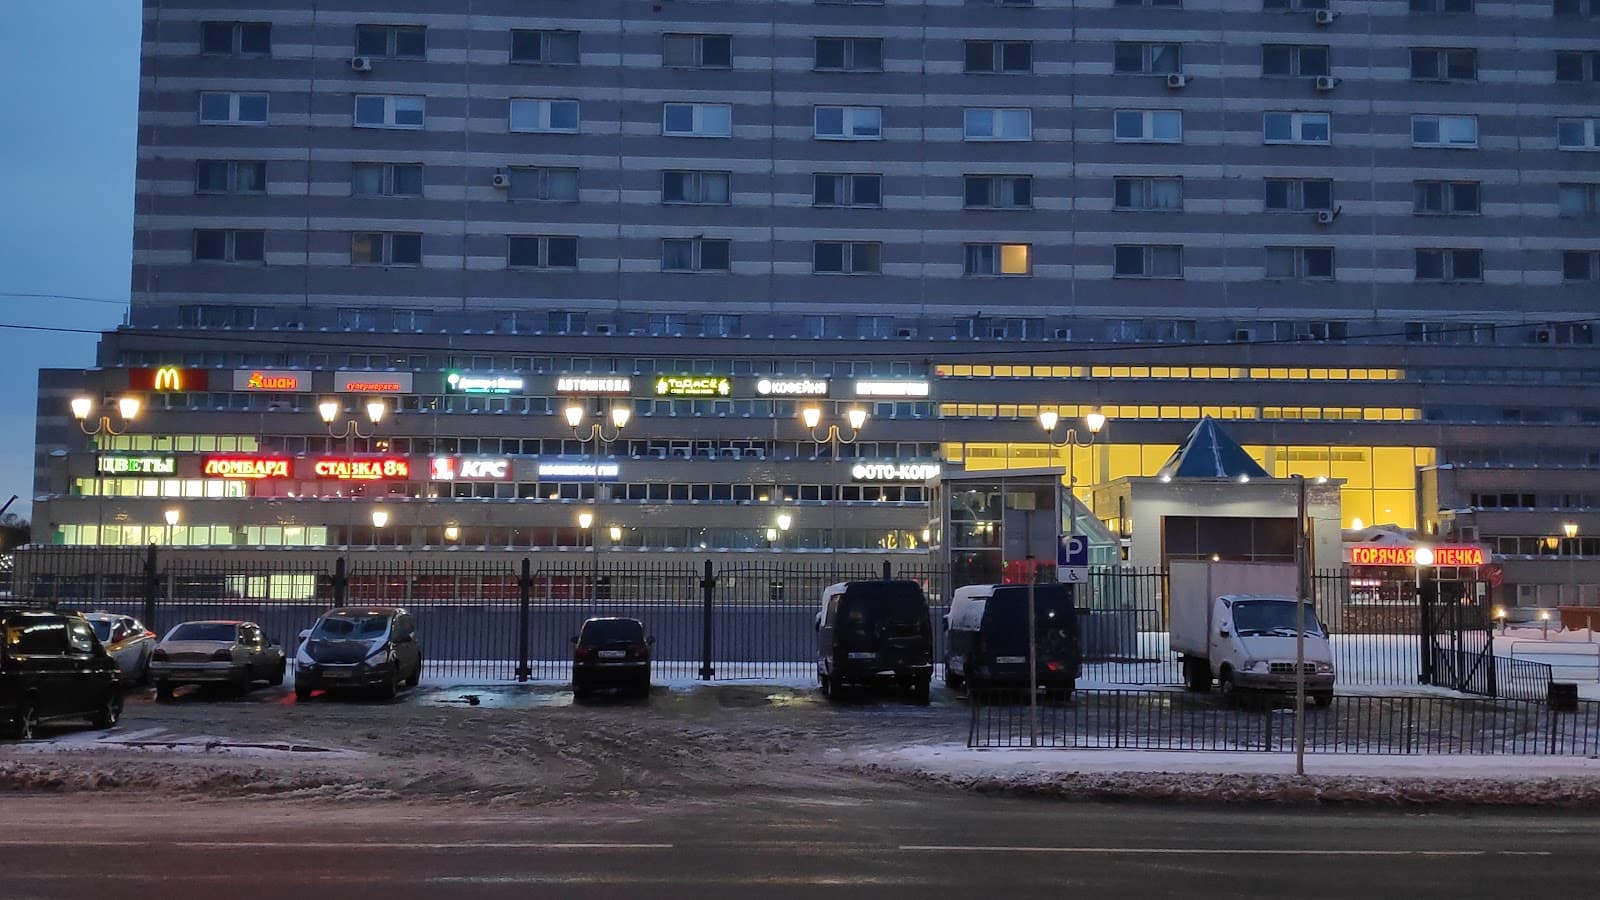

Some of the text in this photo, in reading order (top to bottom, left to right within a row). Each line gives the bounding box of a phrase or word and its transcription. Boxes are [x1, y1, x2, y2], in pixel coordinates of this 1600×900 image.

[557, 378, 631, 392] АВТОШКОЛА
[771, 380, 827, 394] КОФЕЙНЯ
[97, 456, 175, 474] ЦВЕТЫ
[204, 459, 288, 476] ЛОМБАРД
[315, 460, 408, 475] СТАВКА 8%
[461, 461, 507, 478] KFC
[1352, 549, 1414, 564] ГОРЯЧАЯ
